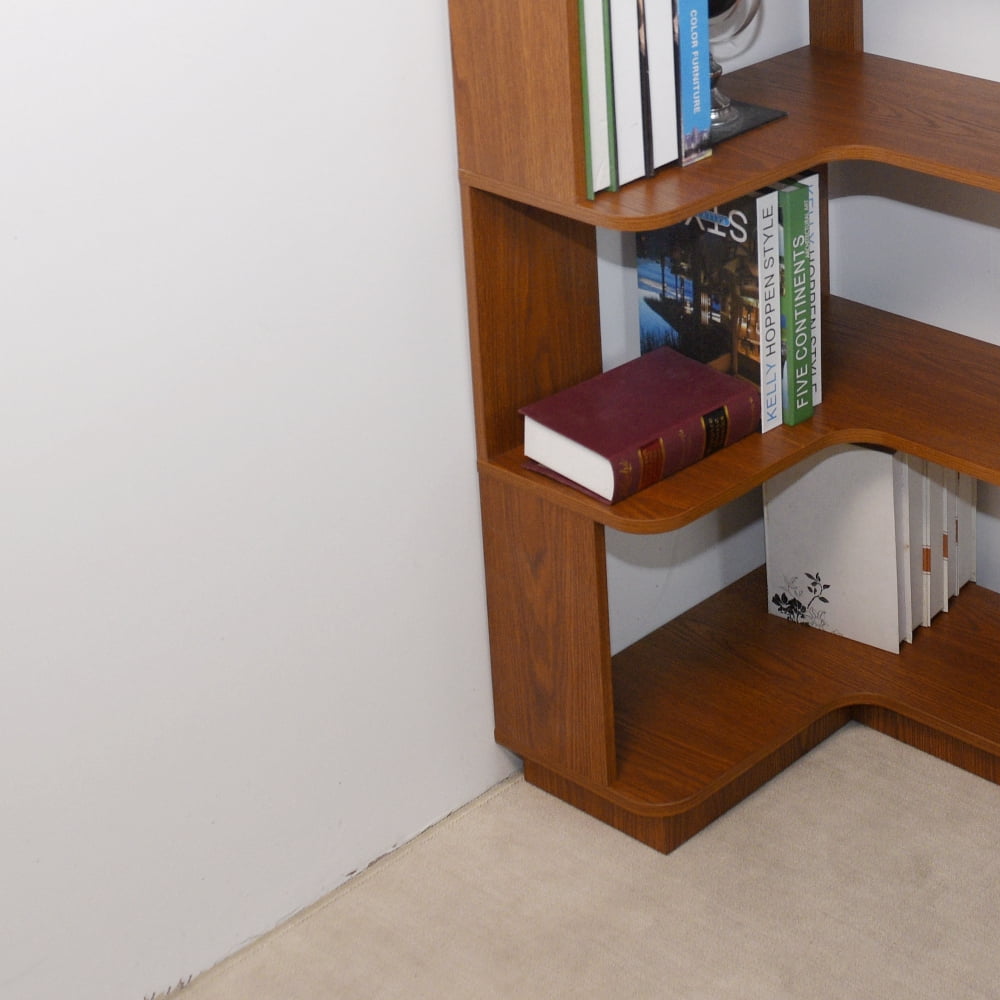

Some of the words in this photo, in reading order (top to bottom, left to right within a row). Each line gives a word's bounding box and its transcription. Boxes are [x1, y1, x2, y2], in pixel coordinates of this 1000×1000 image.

[690, 9, 698, 48] COLOR
[692, 50, 700, 114] FURNITURE
[762, 205, 775, 269] STYLE
[764, 274, 776, 357] HOPPEN
[793, 235, 808, 361] CONTINENTS
[766, 363, 777, 421] KELLY
[796, 363, 809, 409] FIVE
